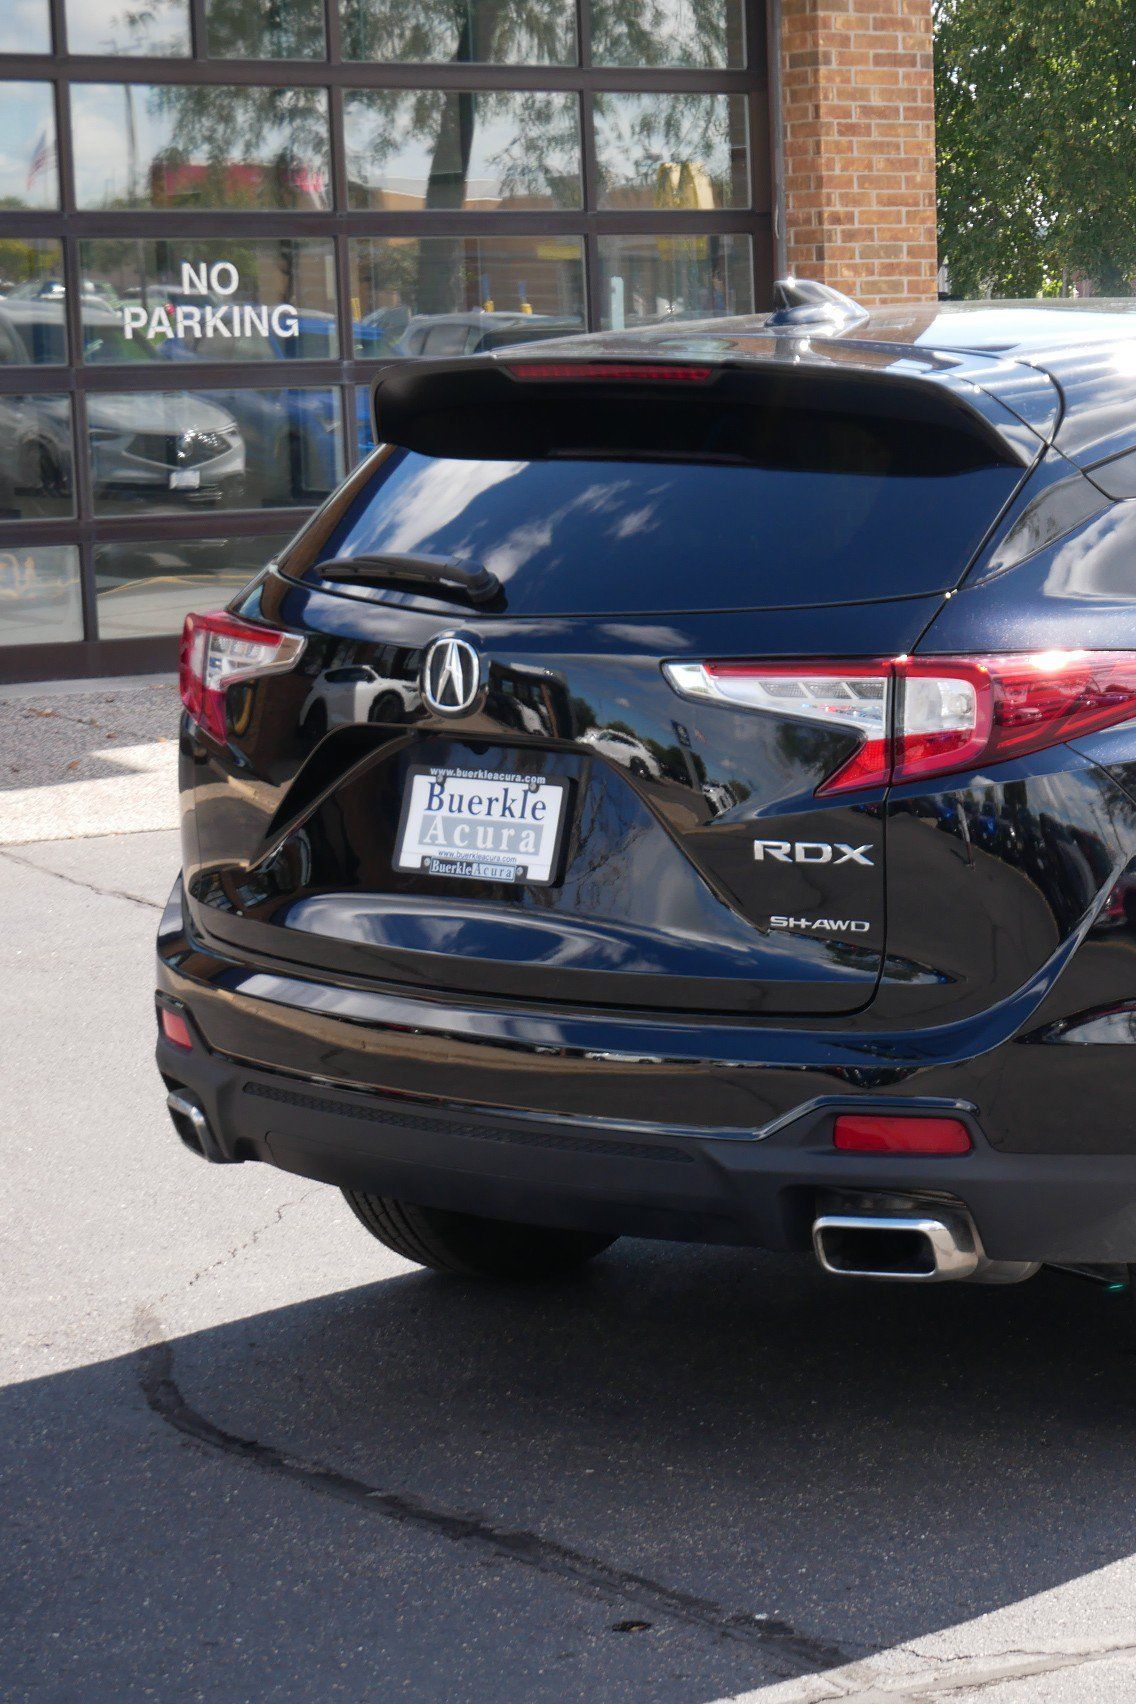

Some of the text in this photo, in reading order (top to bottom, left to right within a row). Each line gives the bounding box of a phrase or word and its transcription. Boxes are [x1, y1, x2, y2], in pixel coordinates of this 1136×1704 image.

[181, 262, 239, 295] NO
[123, 304, 300, 339] PARKING
[430, 767, 546, 784] www.buerkleacura.com
[424, 782, 547, 821] Buerkle
[423, 817, 536, 852] Acura
[438, 850, 517, 863] www.buerkleacura.com
[753, 839, 875, 866] RDX
[431, 859, 512, 878] Buerkle Acura
[769, 915, 870, 932] SH-AWD
